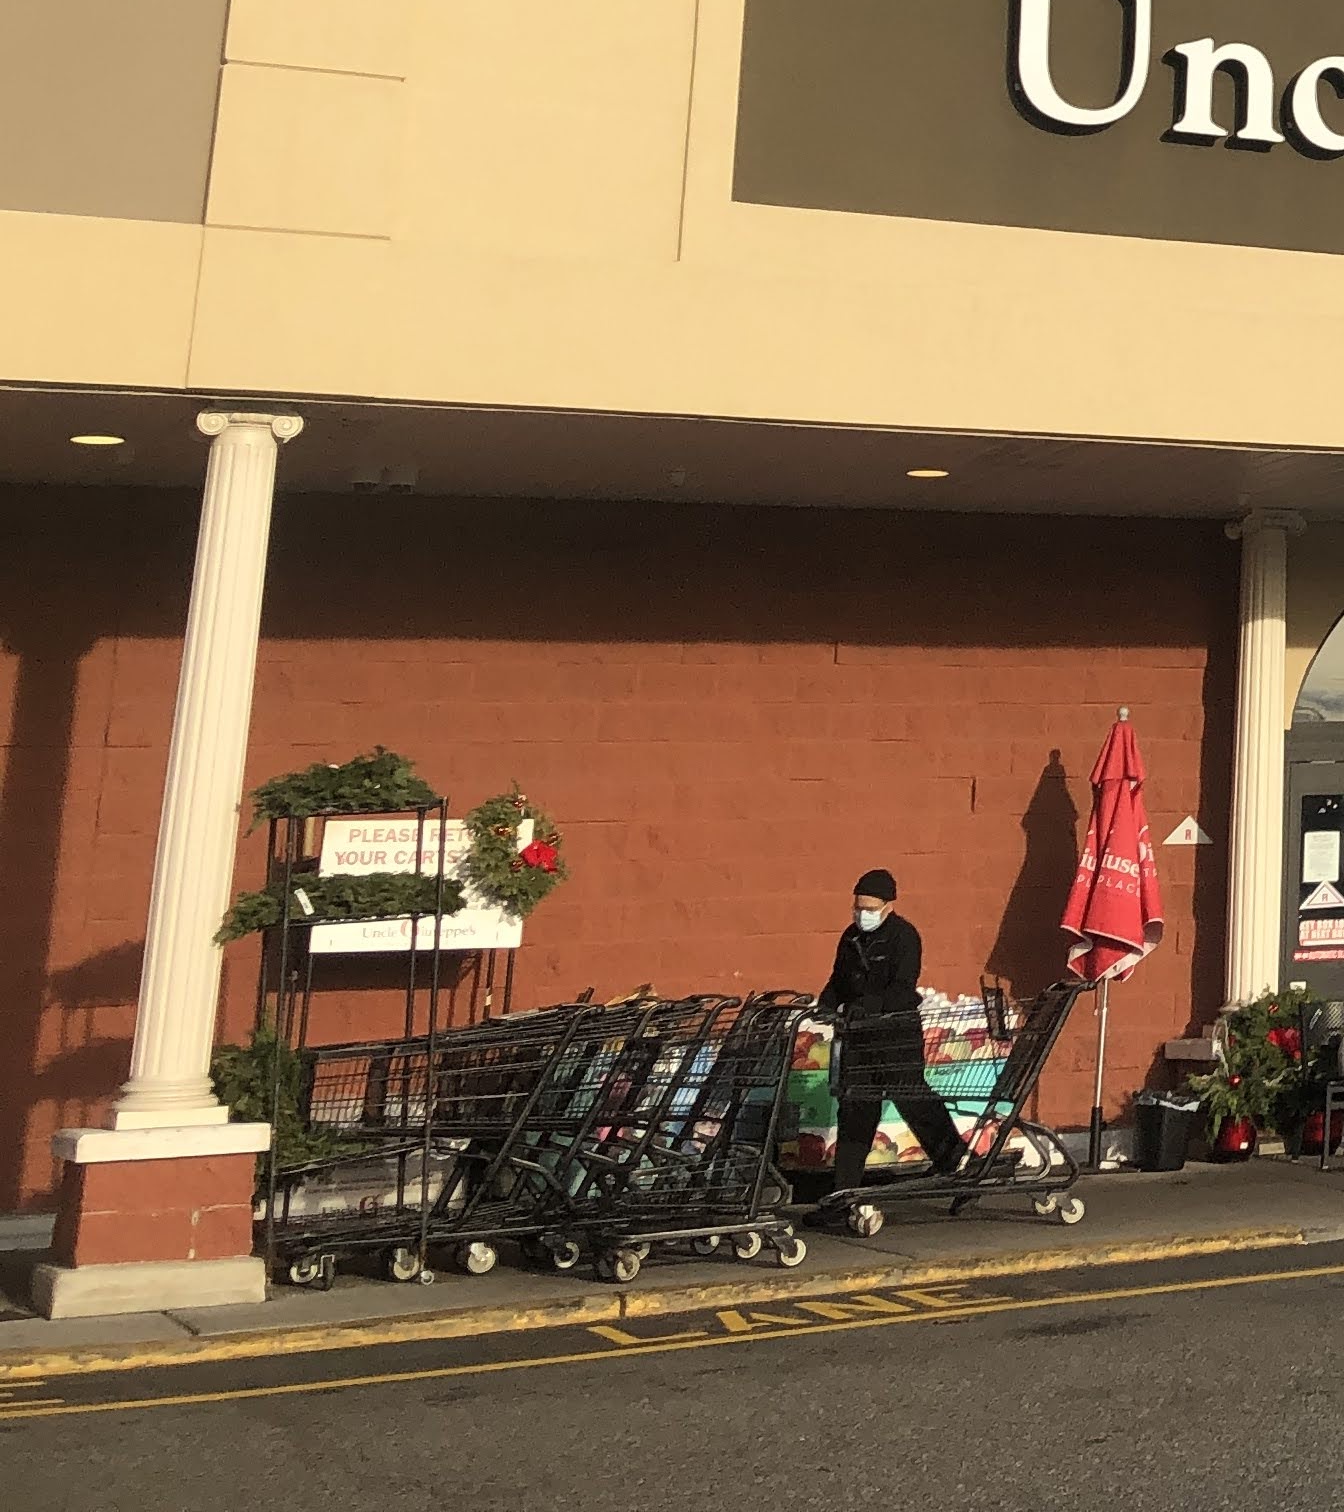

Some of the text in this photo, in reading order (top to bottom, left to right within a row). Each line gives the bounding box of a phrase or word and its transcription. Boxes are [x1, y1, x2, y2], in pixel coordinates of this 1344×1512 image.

[335, 850, 459, 866] YOUR CARS
[586, 1284, 1014, 1346] LANE
